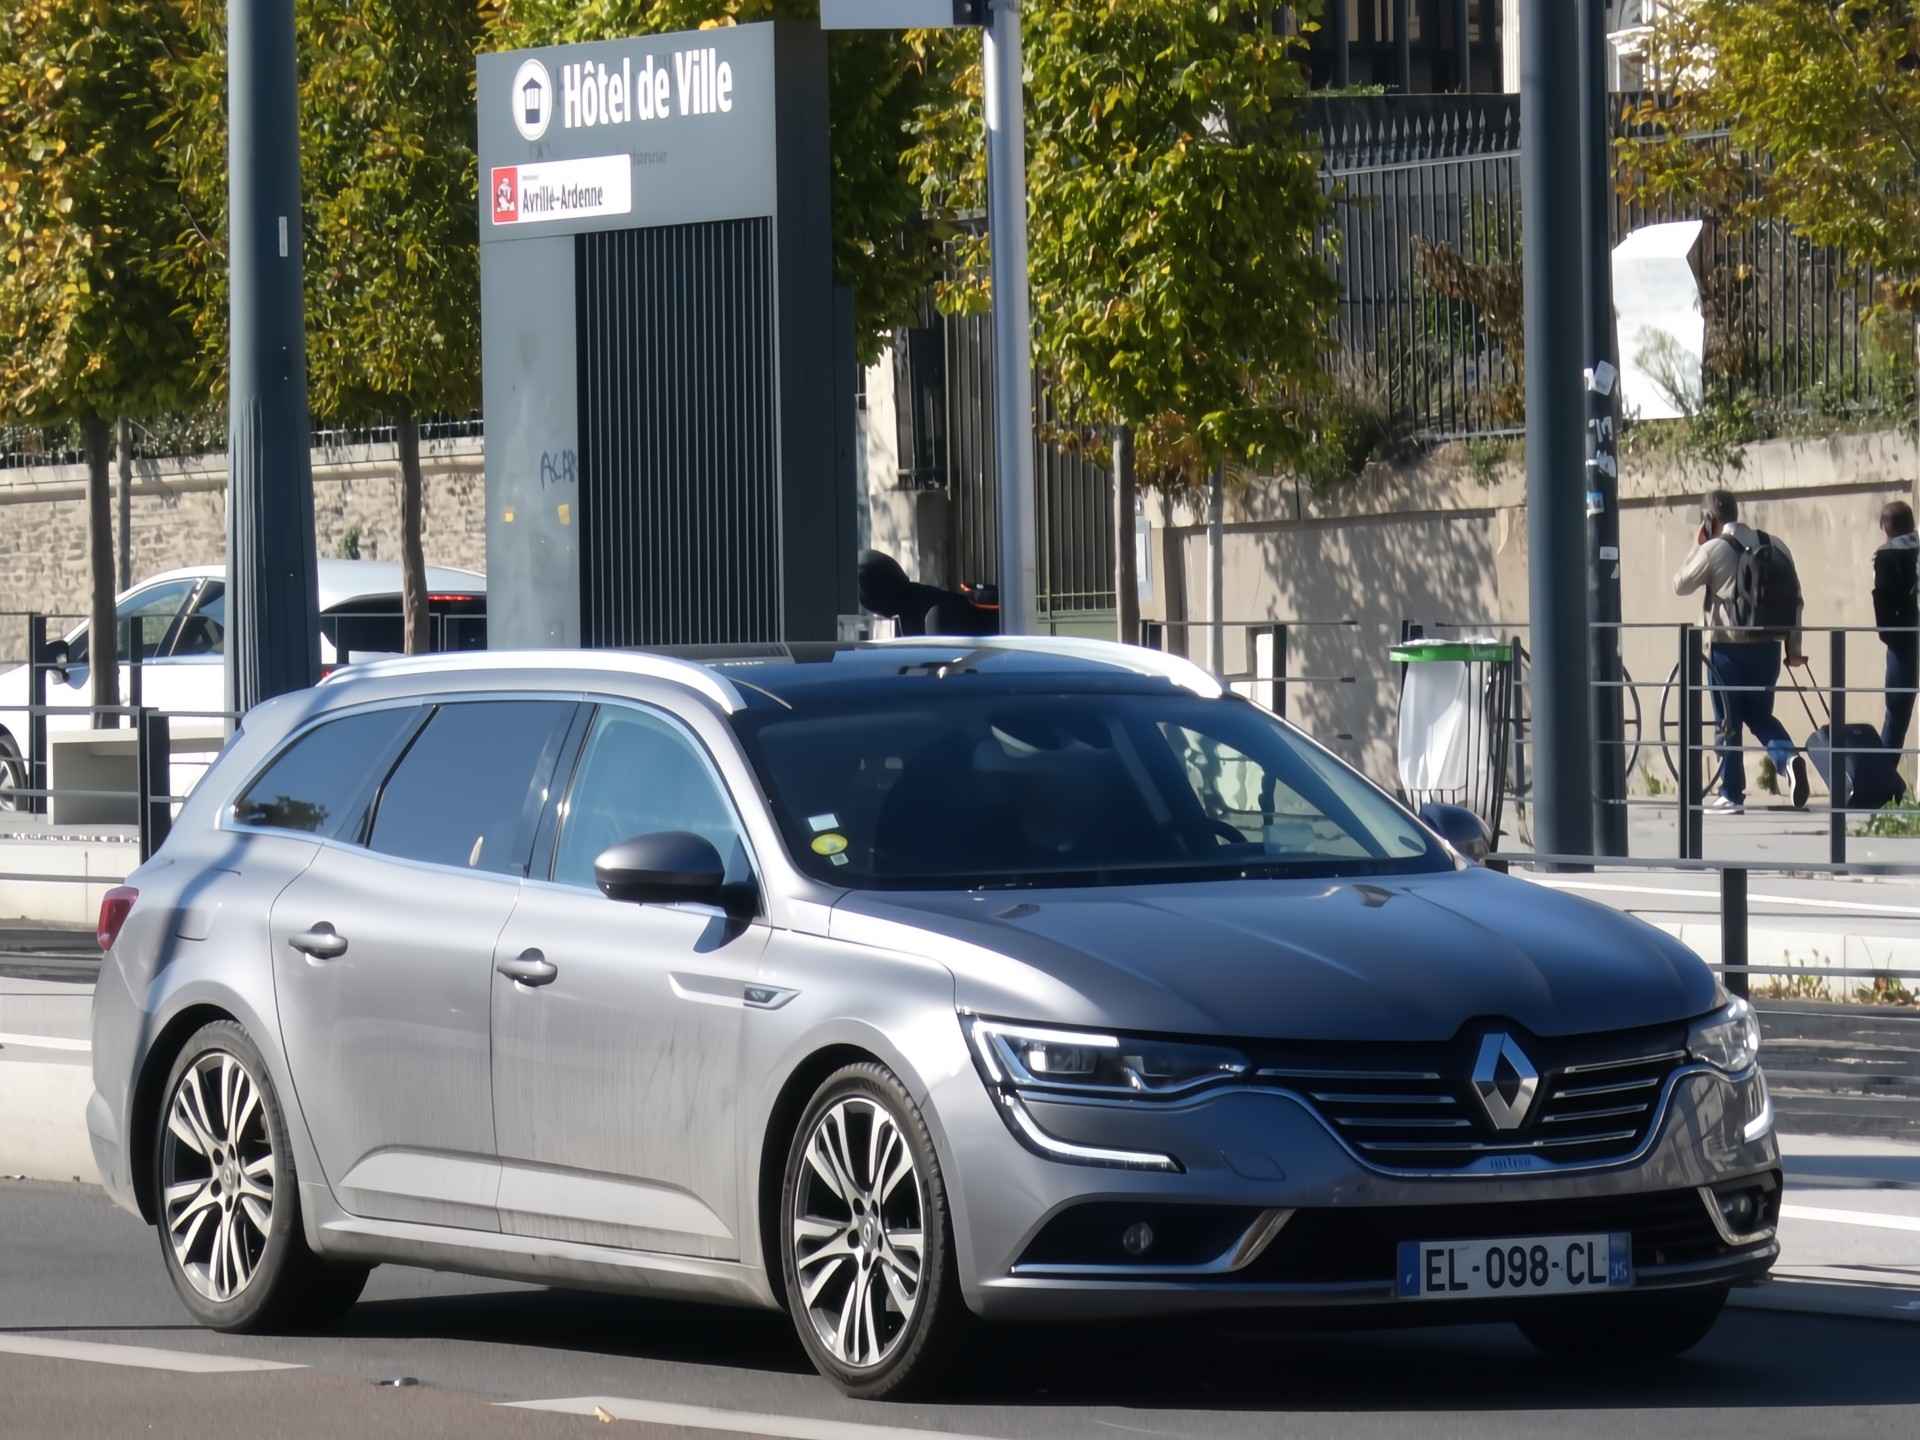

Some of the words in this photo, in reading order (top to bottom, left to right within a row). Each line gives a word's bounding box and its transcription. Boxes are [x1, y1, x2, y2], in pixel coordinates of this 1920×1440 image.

[563, 57, 632, 129] Hôtel
[637, 54, 670, 121] de
[674, 47, 733, 116] Ville
[521, 182, 604, 215] Avrillé-Ardenne
[1426, 1241, 1607, 1292] EL-098-CL
